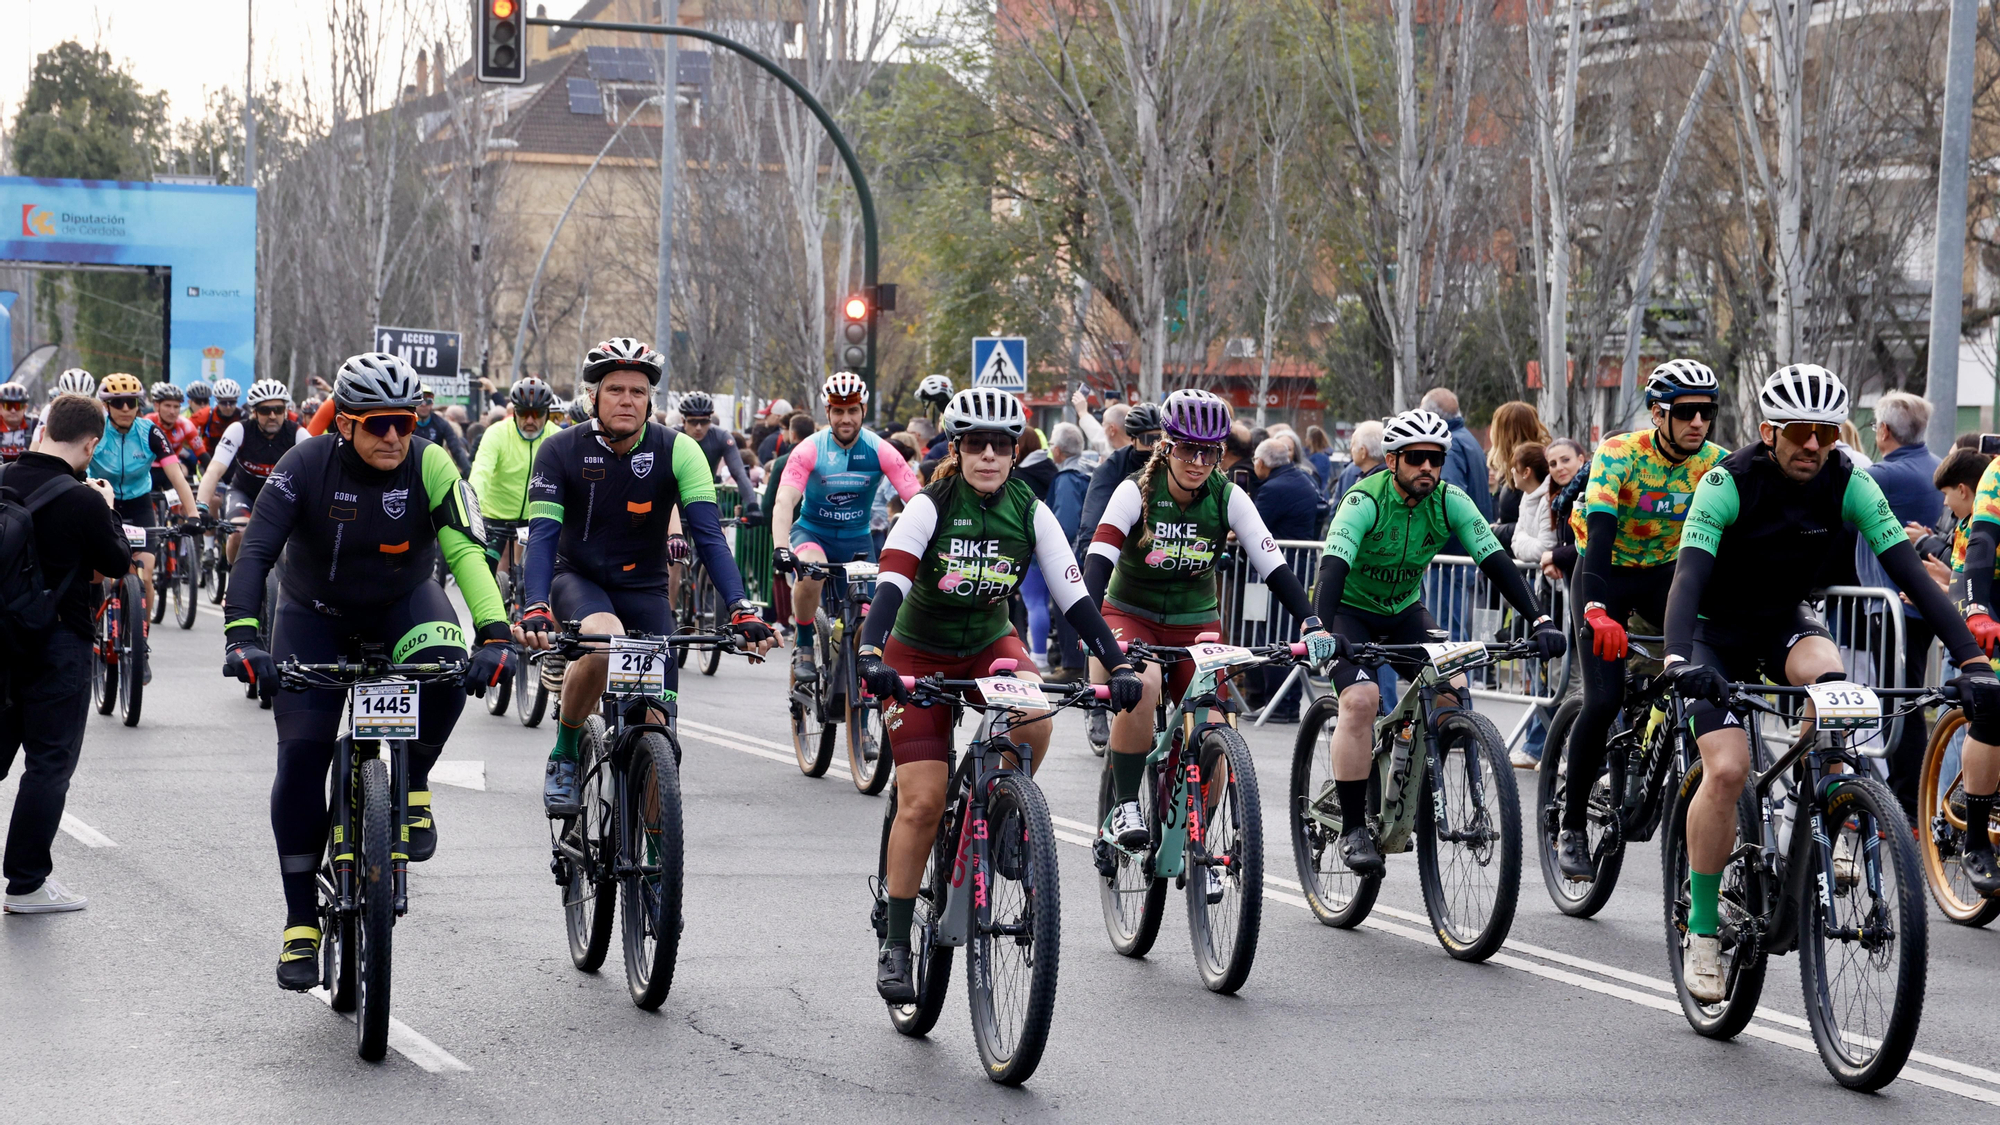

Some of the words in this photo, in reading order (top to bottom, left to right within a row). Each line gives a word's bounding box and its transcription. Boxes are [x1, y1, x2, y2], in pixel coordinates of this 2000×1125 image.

[61, 212, 125, 226] Diputación
[61, 226, 76, 235] de
[79, 225, 126, 237] Córdoba
[201, 287, 241, 298] kavant
[401, 332, 436, 345] ACCESO
[397, 344, 438, 368] MTB
[584, 456, 604, 464] GOBIK
[334, 491, 359, 503] GOBIK
[953, 518, 973, 526] GOBIK
[1154, 521, 1198, 539] BIKE
[950, 538, 1000, 558] BIKE
[1149, 553, 1215, 571] SOPHY
[943, 577, 1014, 597] SOPHY
[621, 653, 652, 672] 218
[993, 683, 1029, 696] 681
[1826, 691, 1865, 706] 313
[362, 696, 411, 714] 1445
[1432, 790, 1446, 822] FOX
[1188, 810, 1200, 842] FOX
[974, 871, 988, 910] FOX
[1816, 871, 1831, 908] FOX
